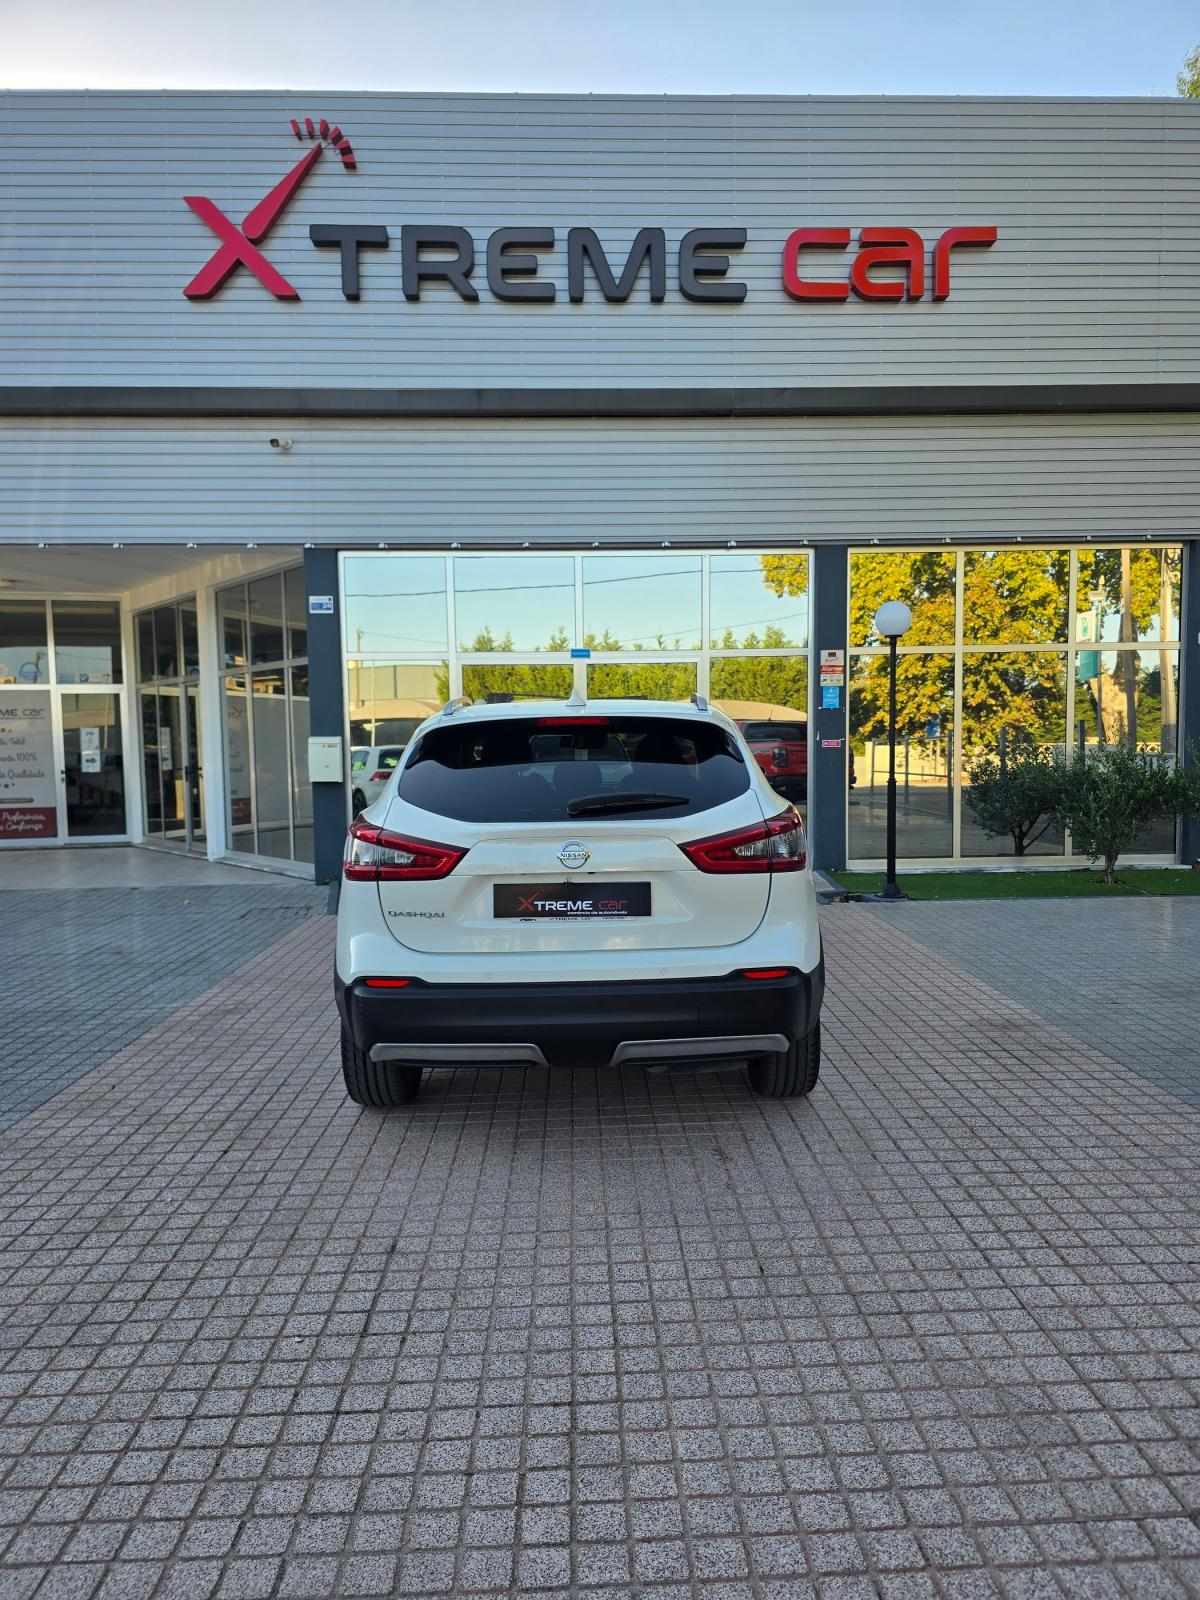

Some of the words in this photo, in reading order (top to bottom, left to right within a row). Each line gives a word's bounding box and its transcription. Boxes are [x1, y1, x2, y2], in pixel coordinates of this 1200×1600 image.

[183, 139, 748, 304] XTREME
[560, 851, 587, 859] NISSAN
[518, 893, 592, 912] XTREME
